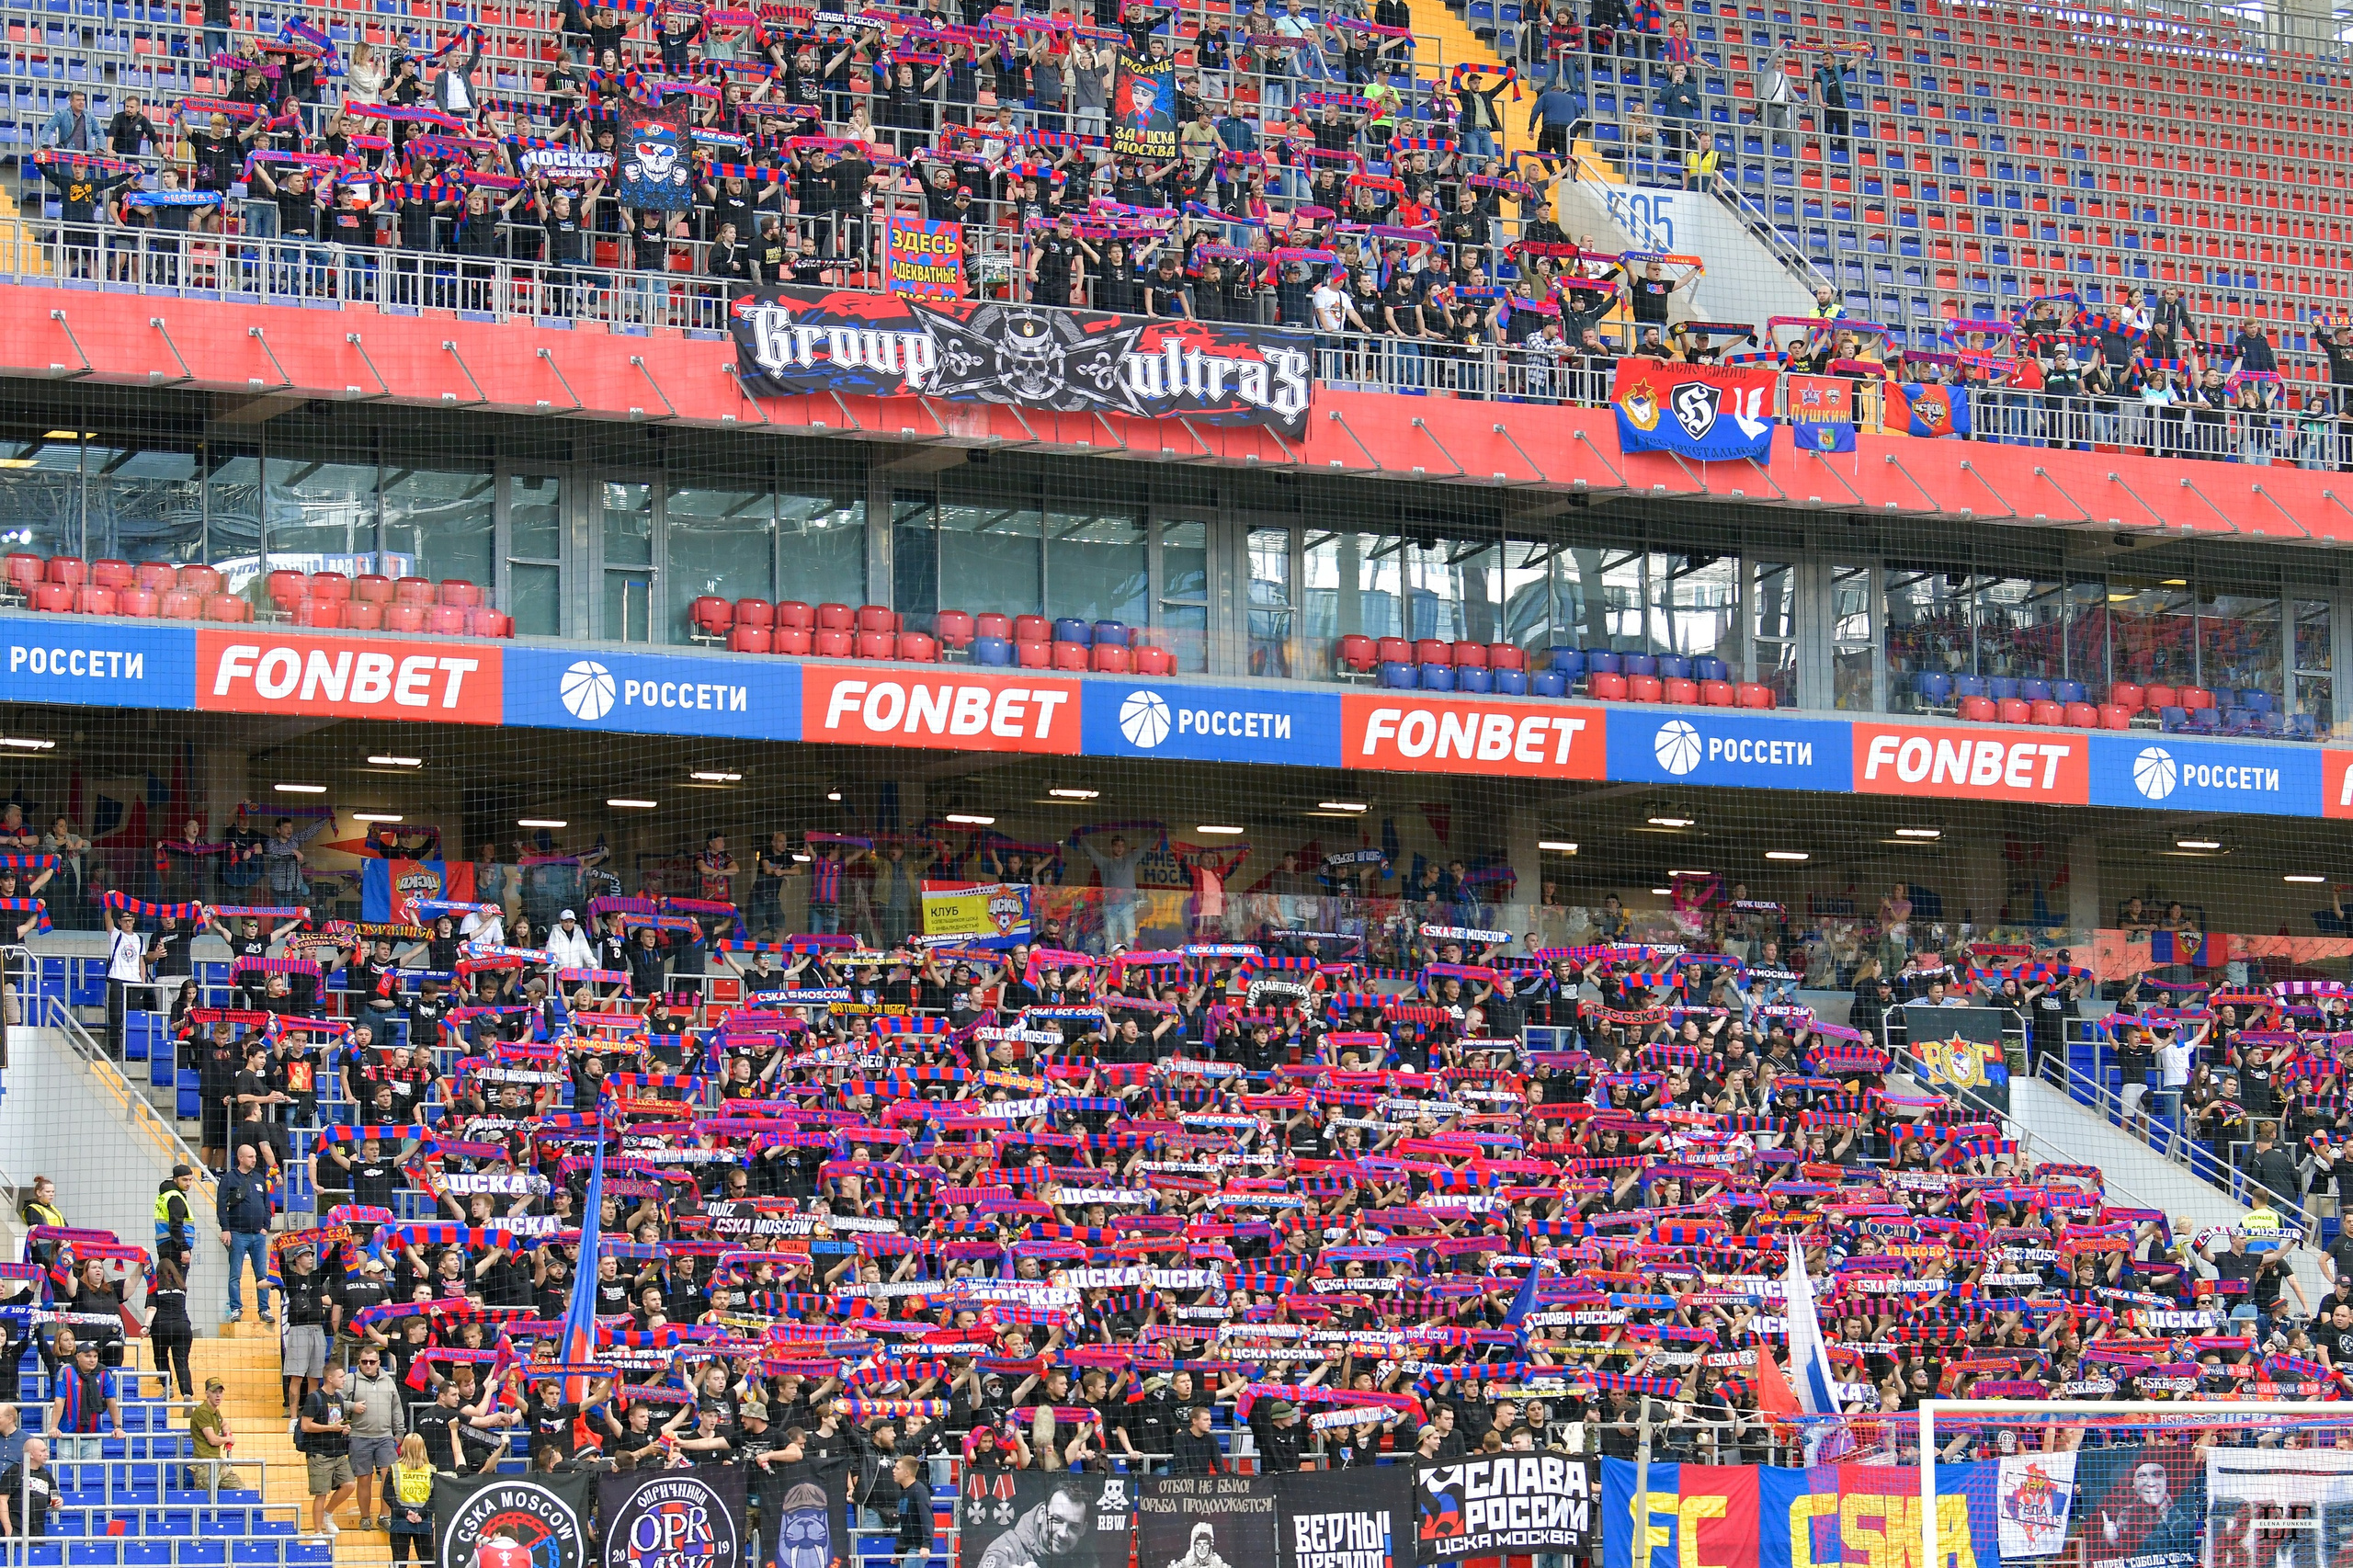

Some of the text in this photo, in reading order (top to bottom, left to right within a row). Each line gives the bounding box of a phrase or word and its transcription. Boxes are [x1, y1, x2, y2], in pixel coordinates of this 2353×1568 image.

[813, 12, 846, 24] СЛАВА
[189, 99, 250, 112] ПФК ЦСКА
[741, 104, 811, 117] ЦСКА
[1115, 126, 1176, 144] ЗА ЦСКА
[1113, 141, 1176, 157] МОСКВА
[525, 151, 617, 168] МОСКВА
[1362, 176, 1394, 187] ЦСКА
[171, 192, 208, 203] ЦСКА
[1608, 191, 1673, 254] 505
[891, 227, 958, 255] ЗДЕСЬ
[891, 261, 957, 286] АДЕКВАТНЫЕ
[9, 645, 144, 679] РОССЕТИ
[213, 643, 478, 710] FONBET
[625, 679, 748, 713] РОССЕТИ
[824, 680, 1068, 740] FONBET
[1177, 708, 1291, 741] РОССЕТИ
[1361, 708, 1586, 765] FONBET
[1708, 735, 1813, 767] РОССЕТИ
[1864, 733, 2070, 790] FONBET
[2182, 762, 2279, 792] РОССЕТИ
[221, 905, 297, 915] ЦСКА МОСКВА
[930, 905, 959, 917] КЛУБ
[989, 898, 1019, 913] ЦСКА
[1756, 902, 1777, 910] ЦСКА
[658, 917, 690, 928] ЦСКА
[1424, 925, 1507, 943] CSKA MOSCOW
[474, 943, 547, 960] ЦСКА МОСКВА
[1189, 946, 1256, 954] ЦСКА МОСКВА
[1756, 969, 1797, 980] МОСКВА
[756, 990, 849, 1003] CSKA MOSCOW
[1595, 1005, 1661, 1023] PFC CSKA
[572, 1037, 642, 1052] ДОМОДЕДОВО
[1021, 1028, 1064, 1045] MOSCOW
[983, 1071, 1045, 1091] УЛЬЯНОВСК
[637, 1098, 673, 1108] ЦСКА
[987, 1097, 1048, 1119] ЦСКА
[1476, 1135, 1514, 1143] МОСКВА
[1218, 1154, 1276, 1165] PFC CSKA
[1687, 1153, 1735, 1164] ЦСКА МОСКВА
[449, 1175, 529, 1195] ЦСКА
[616, 1180, 654, 1195] ЦСКА
[1958, 1177, 2010, 1188] ЦСКА
[1063, 1188, 1134, 1204] ЦСКА
[1269, 1197, 1299, 1205] СЮДА!
[708, 1201, 737, 1218] QUIZ
[494, 1217, 556, 1236] ЦСКА
[716, 1220, 812, 1236] CSKA MOSCOW
[1859, 1221, 1910, 1238] МОСКВА
[811, 1242, 840, 1254] NUMBER
[842, 1243, 857, 1254] ONE
[1886, 1244, 1946, 1257] ИВАНОВО
[2099, 1239, 2130, 1250] ЦСКА
[1070, 1267, 1142, 1288] ЦСКА
[1152, 1269, 1221, 1290] ЦСКА
[1313, 1278, 1398, 1292] ЦСКА МОСКВА
[1858, 1278, 1944, 1293] CSKA MOSCOW
[836, 1284, 867, 1297] CSKA
[972, 1288, 1083, 1305] МОСКВА
[1622, 1295, 1663, 1305] ЦСКА
[1692, 1297, 1749, 1305] ЦСКА МОСКВА
[1531, 1312, 1625, 1325] СЛАВА РОССИИ
[2149, 1312, 2214, 1328] ЦСКА
[1349, 1331, 1404, 1345] РОССИИ
[1406, 1329, 1449, 1340] ПФК ЦСКА
[892, 1344, 987, 1356] ЦСКА МОСКВА
[1232, 1348, 1324, 1360] ЦСКА МОСКВА
[1360, 1344, 1388, 1355] ЦСКА
[1708, 1353, 1740, 1366] CSKA
[527, 1364, 613, 1374] ПФК ЦСКА
[2066, 1380, 2091, 1393] CSKA
[2141, 1376, 2170, 1390] CSKA
[862, 1400, 924, 1414] СУРГУТ
[1159, 1478, 1195, 1495] ОТБОЯ
[1199, 1479, 1213, 1494] НЕ
[1464, 1460, 1589, 1500] СЛАВА
[637, 1483, 710, 1509] ОПРИЧНИКИ
[457, 1491, 574, 1543] CSKA MOSCOW
[1465, 1495, 1589, 1532] РОССИИ
[631, 1506, 713, 1553] OPR
[1097, 1515, 1127, 1532] RBW
[1629, 1491, 1973, 1568] FC CSKA
[1292, 1512, 1382, 1552] ВЕРНЫ
[1435, 1528, 1578, 1555] ЦСКА МОСКВА
[612, 1540, 731, 1563] 20 19
